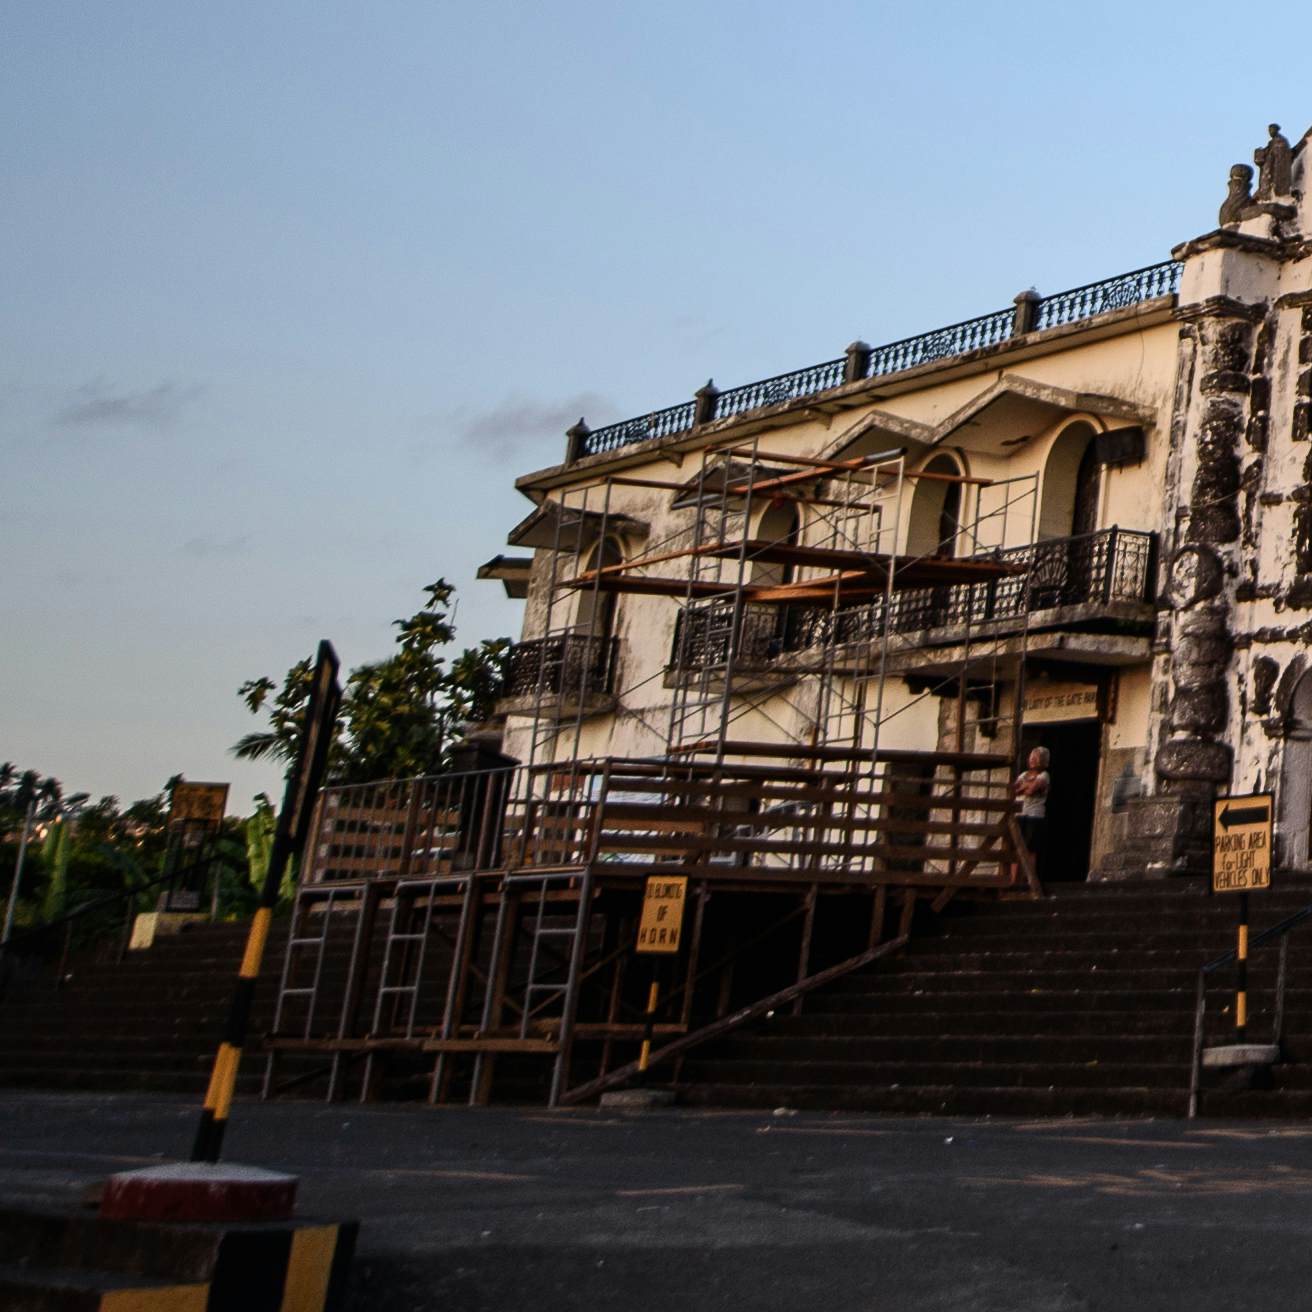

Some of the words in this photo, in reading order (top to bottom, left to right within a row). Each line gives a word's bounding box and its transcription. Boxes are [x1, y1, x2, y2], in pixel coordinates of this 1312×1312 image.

[1215, 832, 1246, 852] PARKING
[1248, 830, 1267, 850] AREA
[1235, 850, 1256, 870] LIGHT
[1215, 868, 1248, 889] VEHICLES
[1251, 867, 1271, 886] ONLY
[656, 904, 669, 922] OF
[639, 927, 678, 944] HORN
